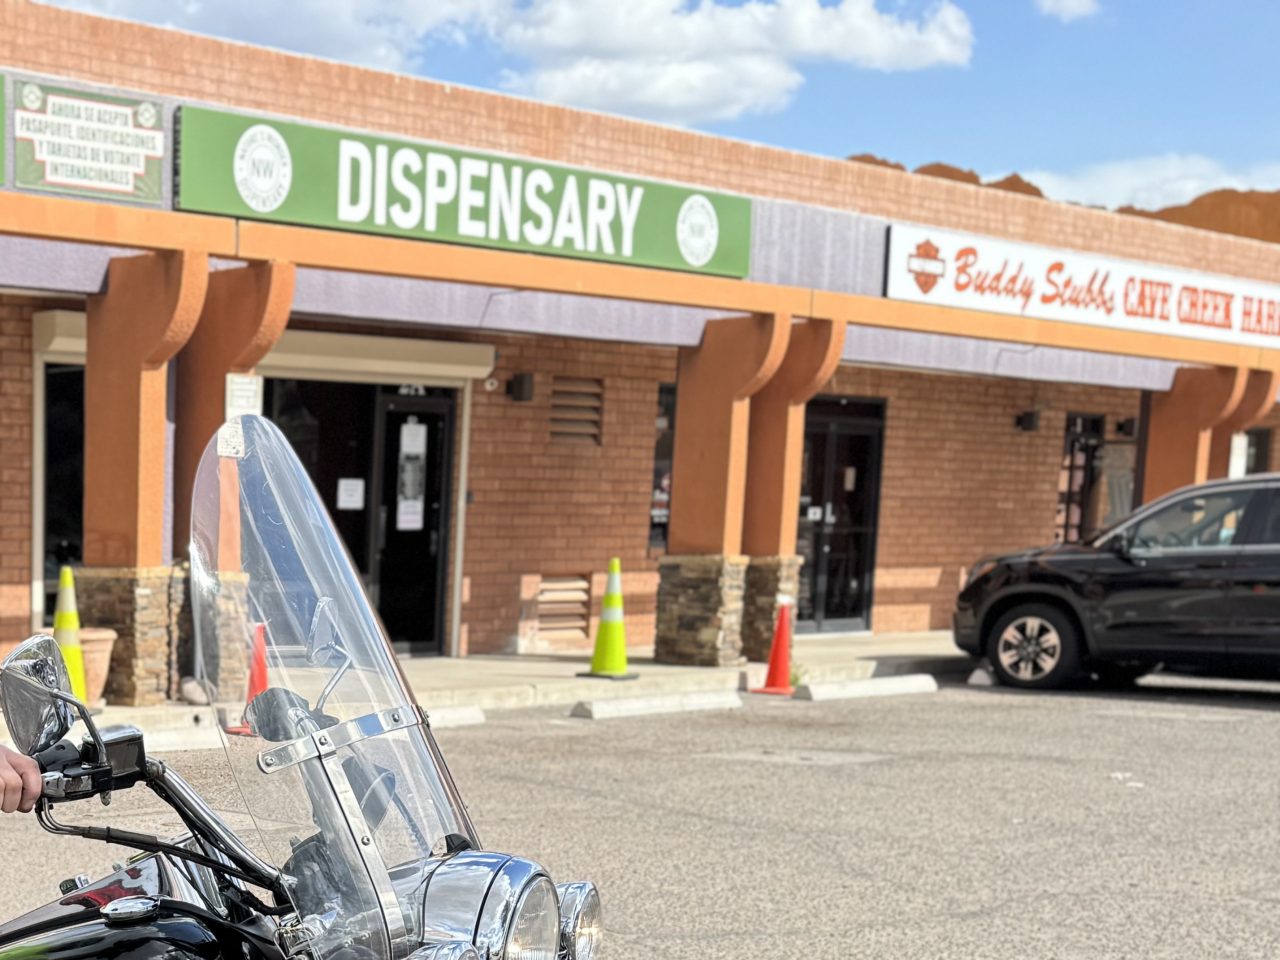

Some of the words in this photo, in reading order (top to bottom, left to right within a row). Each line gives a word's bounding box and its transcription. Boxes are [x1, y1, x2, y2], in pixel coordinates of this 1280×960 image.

[336, 138, 645, 258] DISPENSARY
[953, 247, 1035, 312] Buddy
[1040, 261, 1116, 316] Stubbs
[1123, 276, 1172, 321] CAVE
[1177, 285, 1235, 330] CREEK
[1241, 295, 1280, 337] HAR
